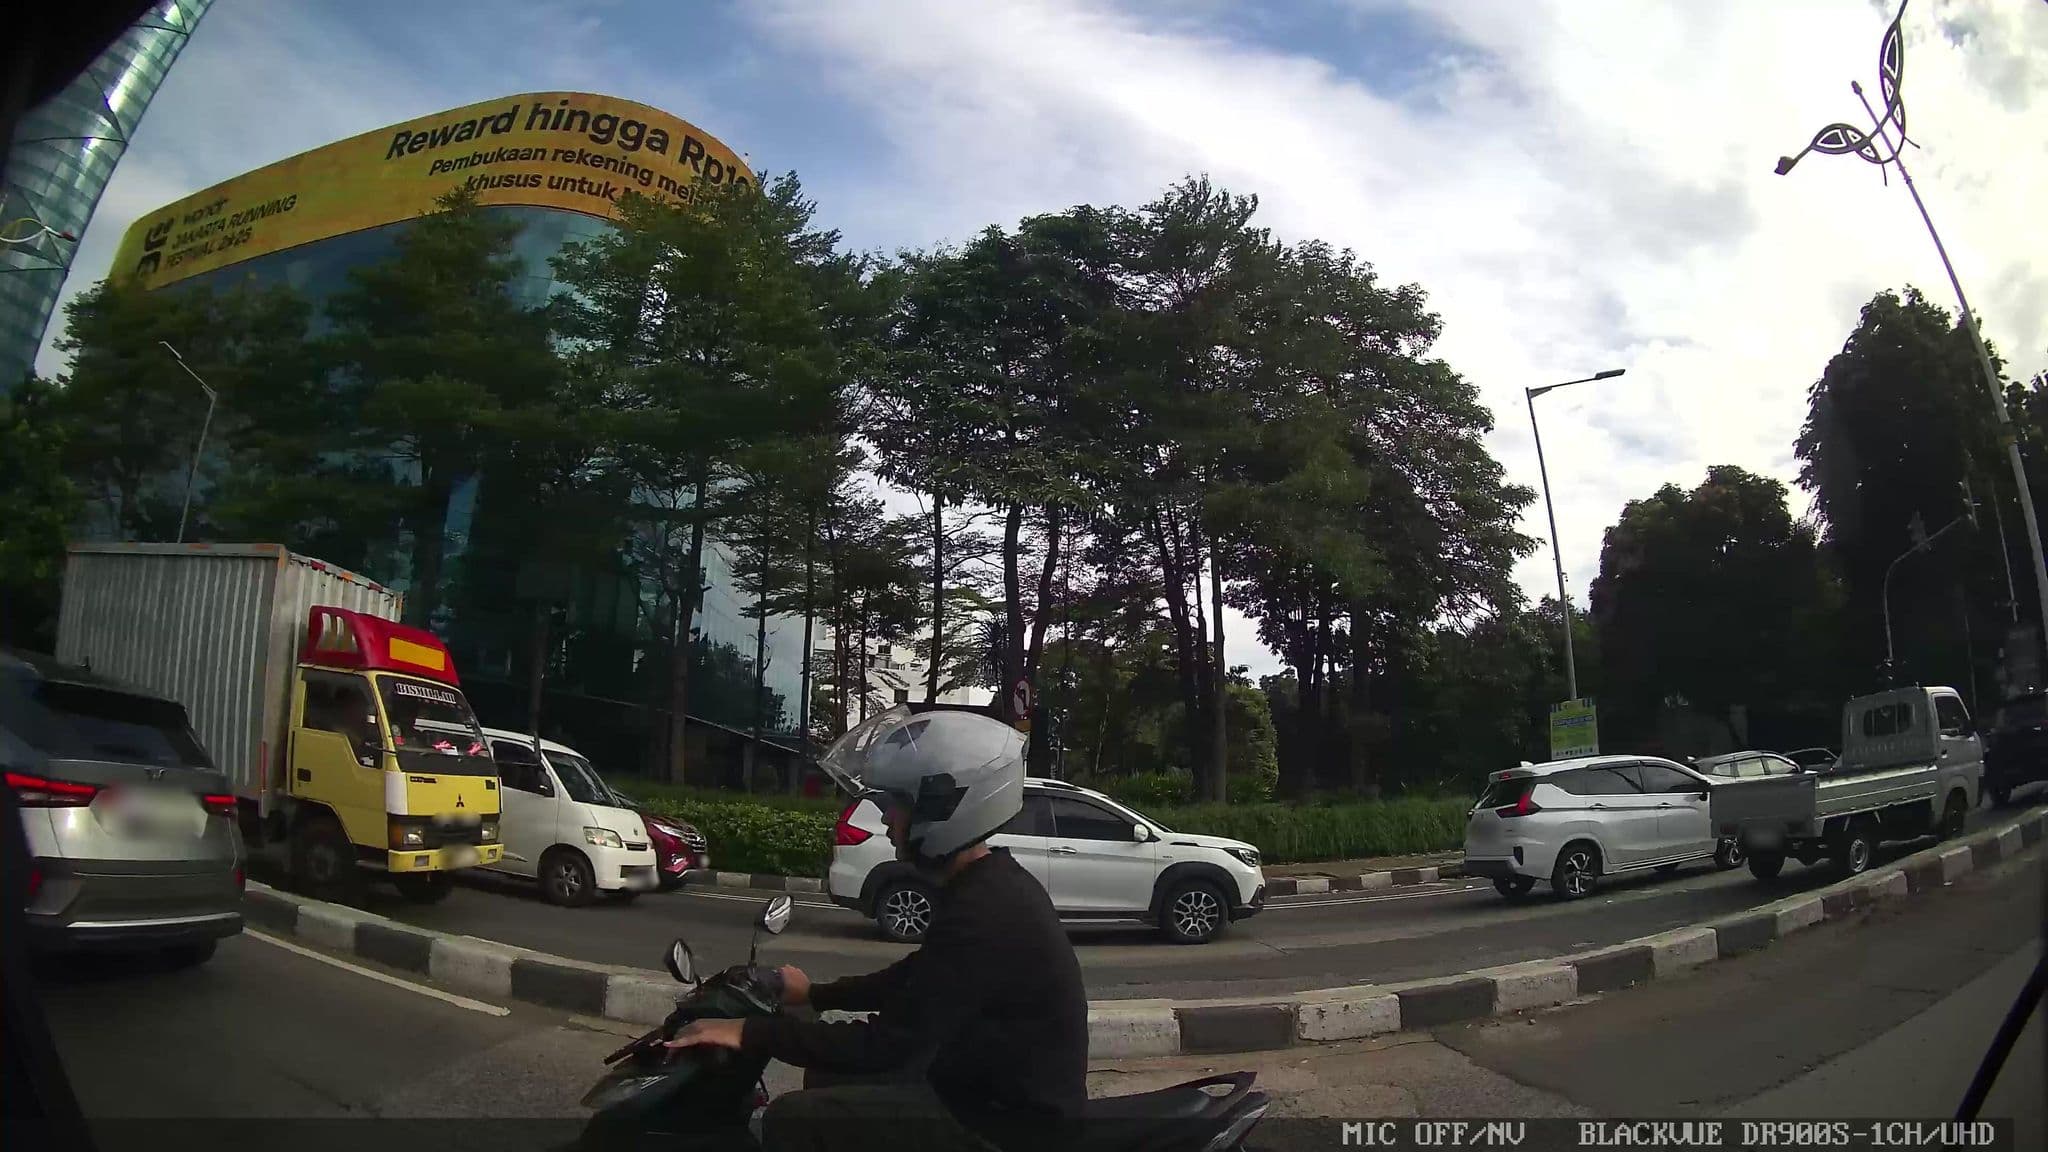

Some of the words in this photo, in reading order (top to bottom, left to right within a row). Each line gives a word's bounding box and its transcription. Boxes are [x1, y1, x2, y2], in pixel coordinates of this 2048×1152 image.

[384, 104, 521, 160] Reward
[524, 100, 670, 156] hingga
[429, 146, 548, 176] Pembukaan
[551, 147, 654, 187] rekening
[466, 172, 543, 193] khusus
[547, 174, 617, 202] untuk
[226, 194, 298, 230] RUNNING
